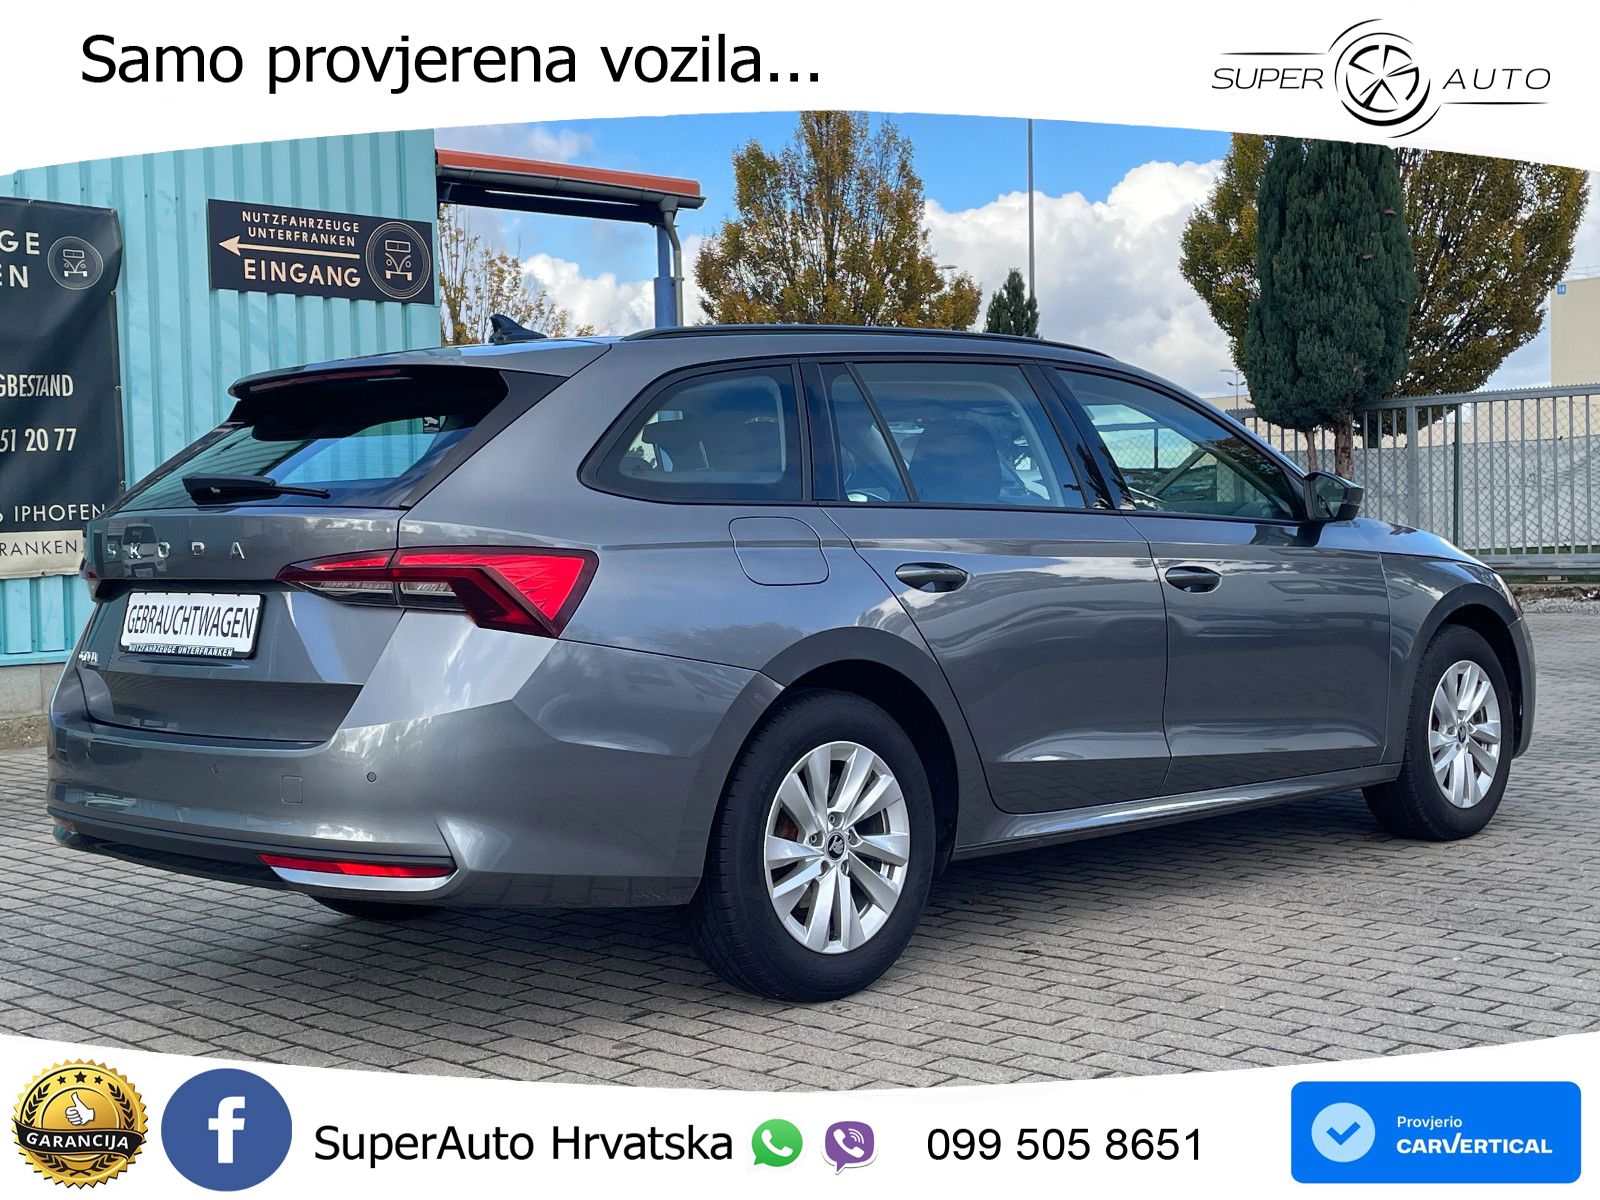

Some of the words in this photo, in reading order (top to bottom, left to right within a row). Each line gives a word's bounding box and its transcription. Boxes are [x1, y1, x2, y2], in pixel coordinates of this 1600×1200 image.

[242, 210, 360, 233] NUTZFAHRZEUGE
[248, 226, 355, 247] UNTERFRANKEN
[0, 264, 29, 288] N
[243, 258, 361, 288] EINGANG
[0, 428, 16, 453] 51
[24, 428, 49, 452] 20
[54, 428, 77, 452] 77
[14, 503, 105, 522] IPHOFEN
[127, 604, 255, 639] GEBRAUCHTWAGEN
[178, 646, 233, 657] UNTERFRANKEN
